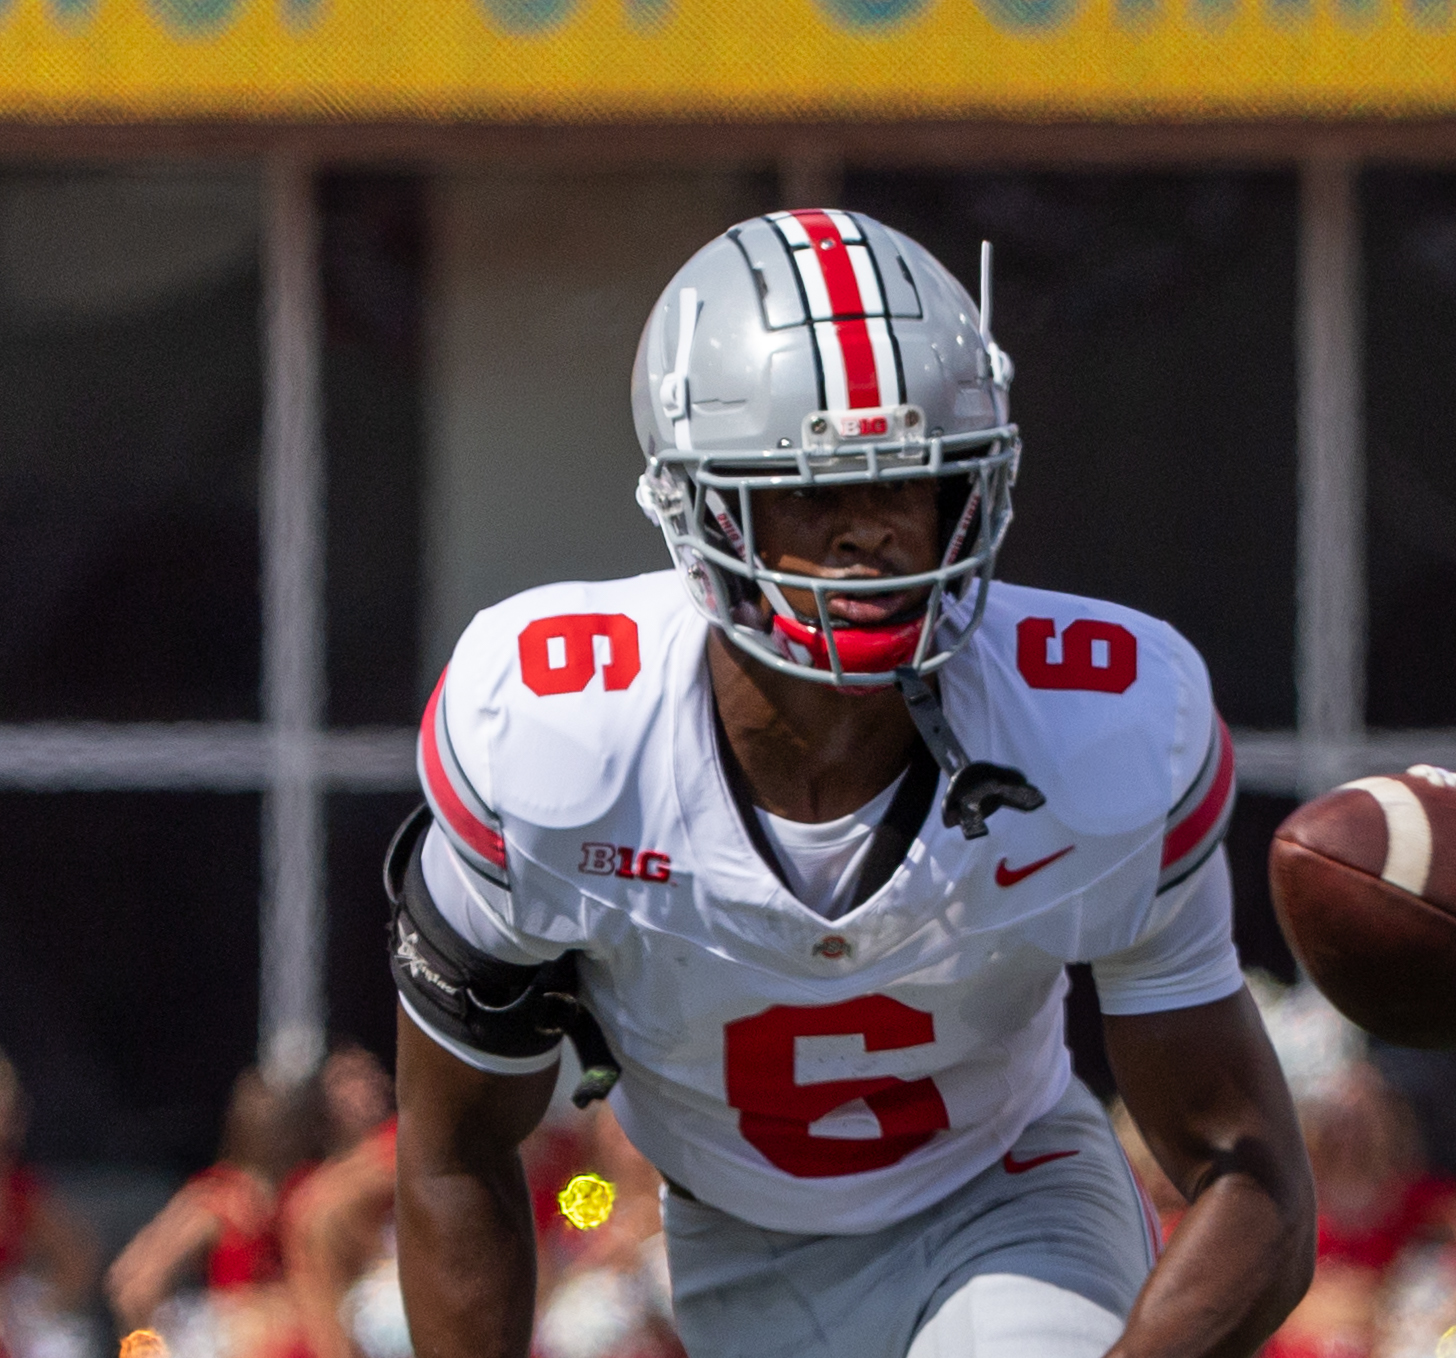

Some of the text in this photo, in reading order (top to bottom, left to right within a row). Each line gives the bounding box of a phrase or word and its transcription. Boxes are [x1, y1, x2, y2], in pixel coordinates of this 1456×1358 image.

[518, 613, 641, 697] 6
[1016, 616, 1138, 694] 6
[723, 992, 949, 1178] 6
